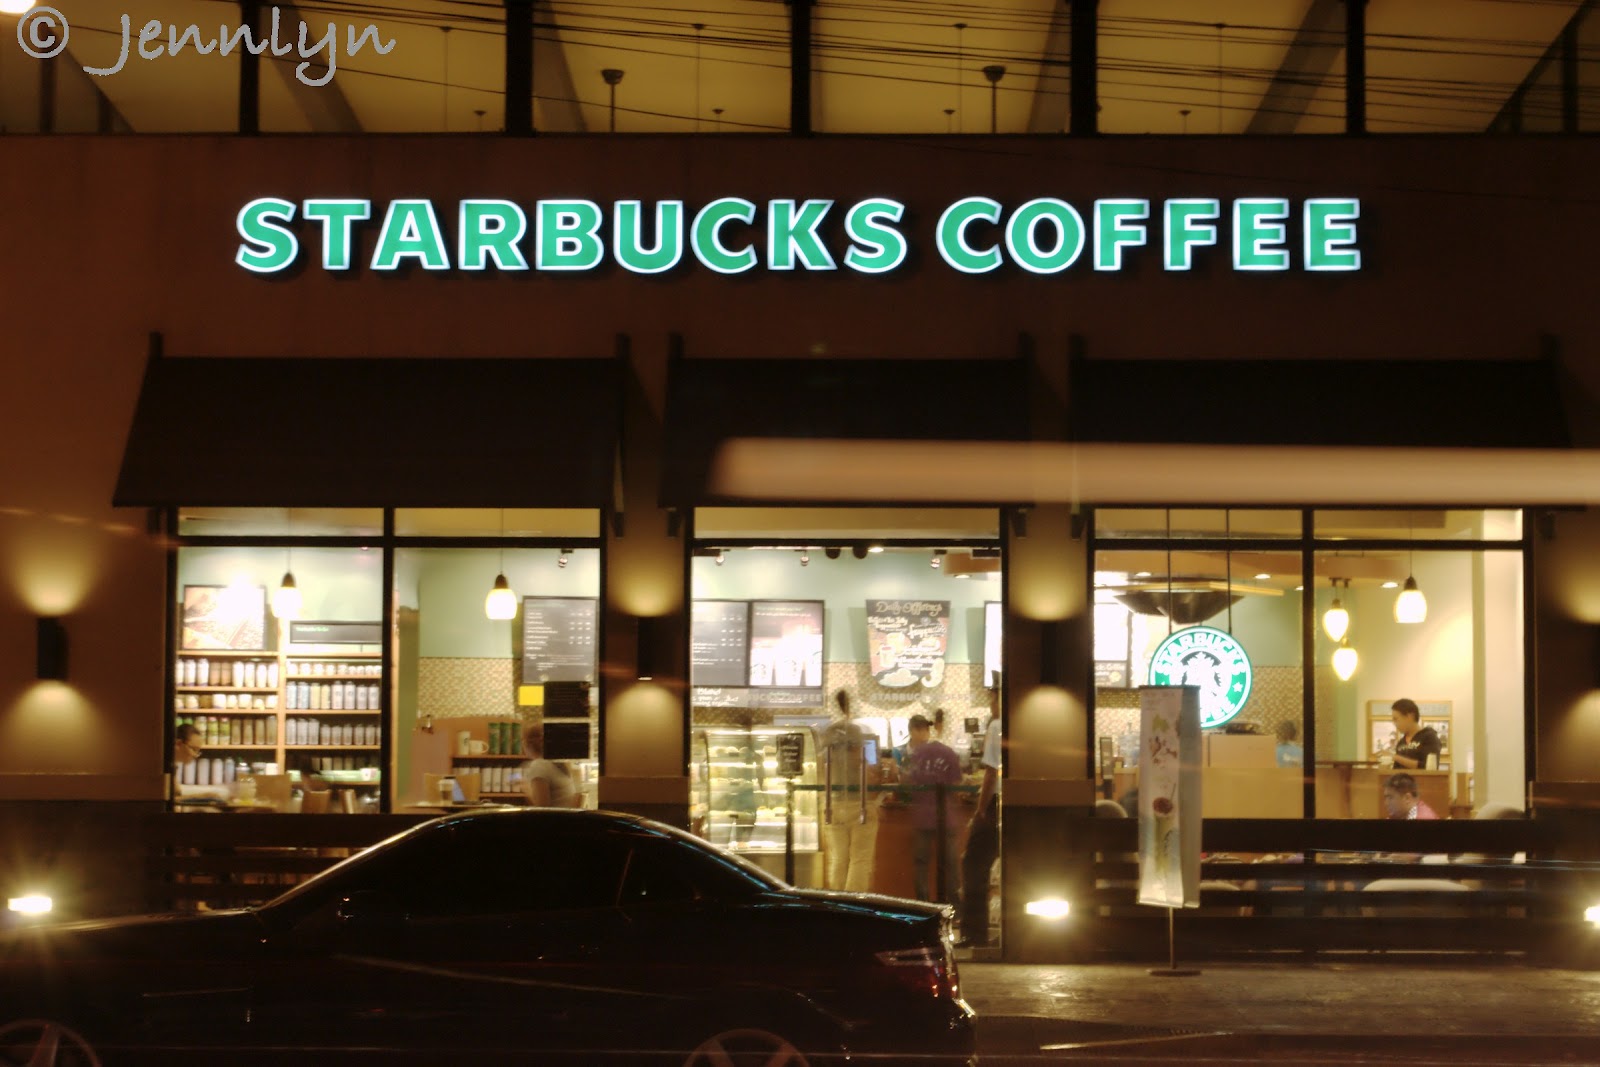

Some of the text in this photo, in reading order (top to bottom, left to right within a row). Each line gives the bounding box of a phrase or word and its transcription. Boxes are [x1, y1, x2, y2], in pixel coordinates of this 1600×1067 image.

[235, 196, 1362, 274] STARBUCKS COFFEE
[1155, 632, 1248, 676] STARBUCKS
